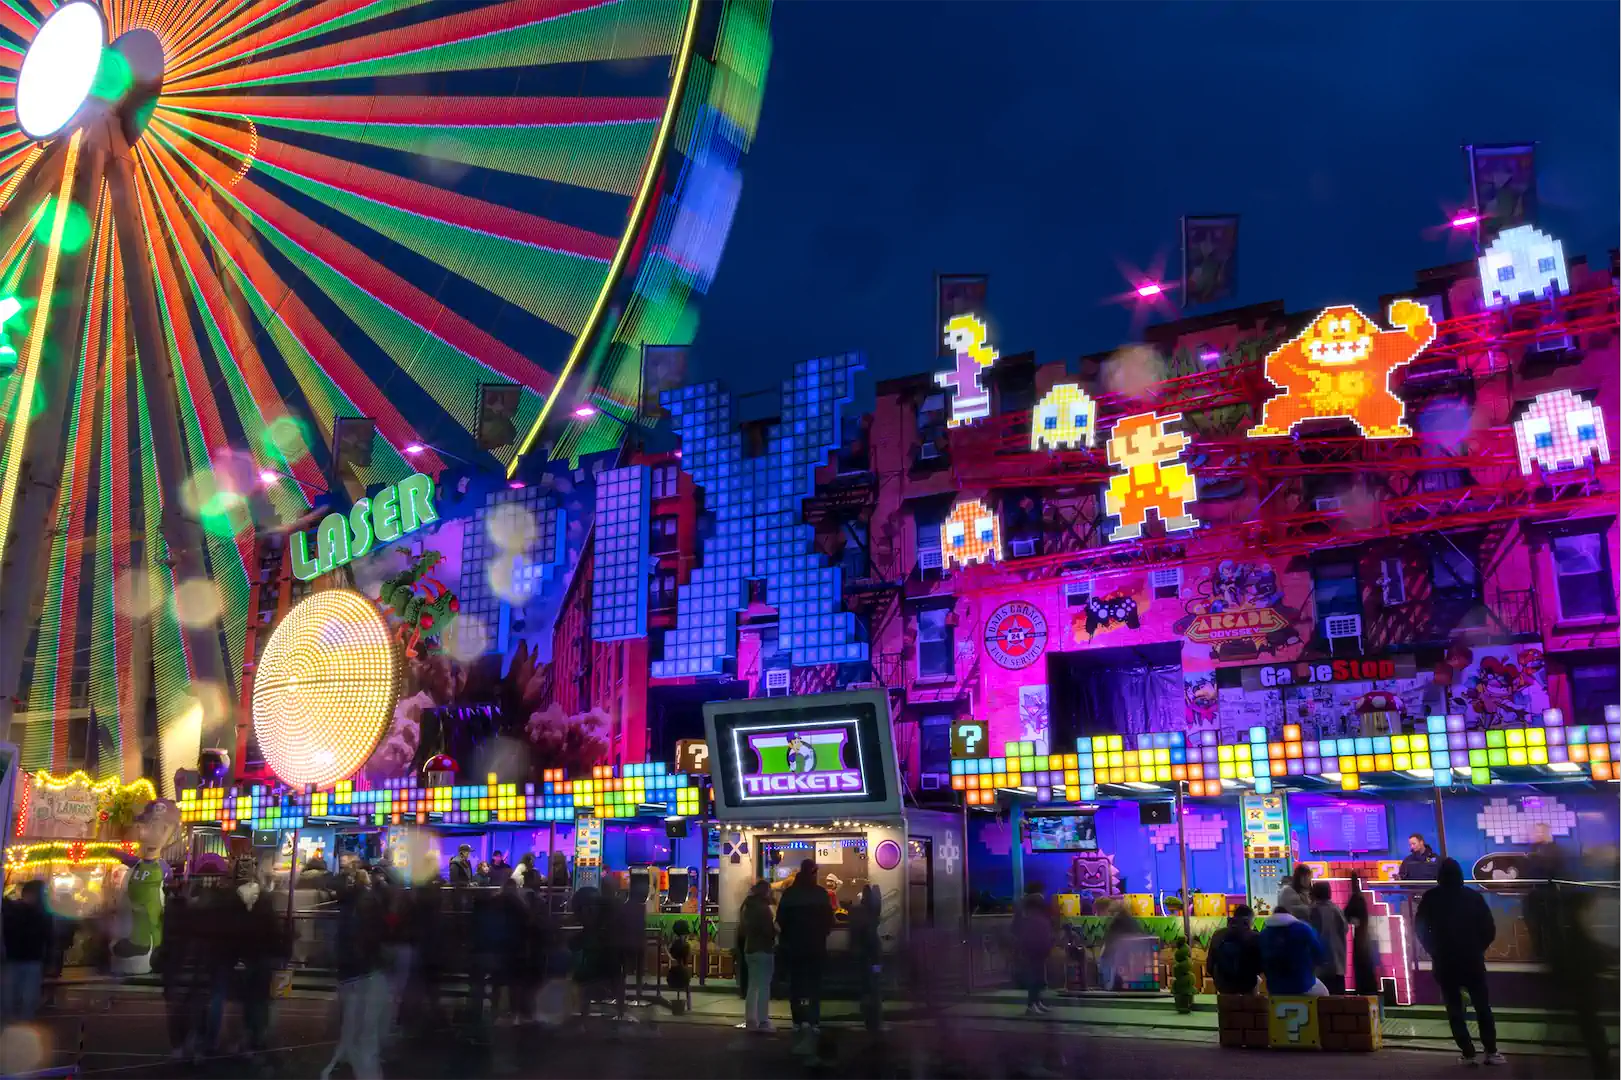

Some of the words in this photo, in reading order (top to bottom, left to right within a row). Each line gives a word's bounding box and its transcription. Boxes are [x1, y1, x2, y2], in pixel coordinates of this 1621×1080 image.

[289, 472, 439, 581] LASER
[1010, 604, 1043, 628] GARAGE
[1198, 610, 1273, 631] ARCADE
[1209, 627, 1260, 638] ODYSSEY
[1010, 643, 1041, 666] SERVICE
[744, 770, 861, 795] TICKETS
[817, 848, 829, 857] 16
